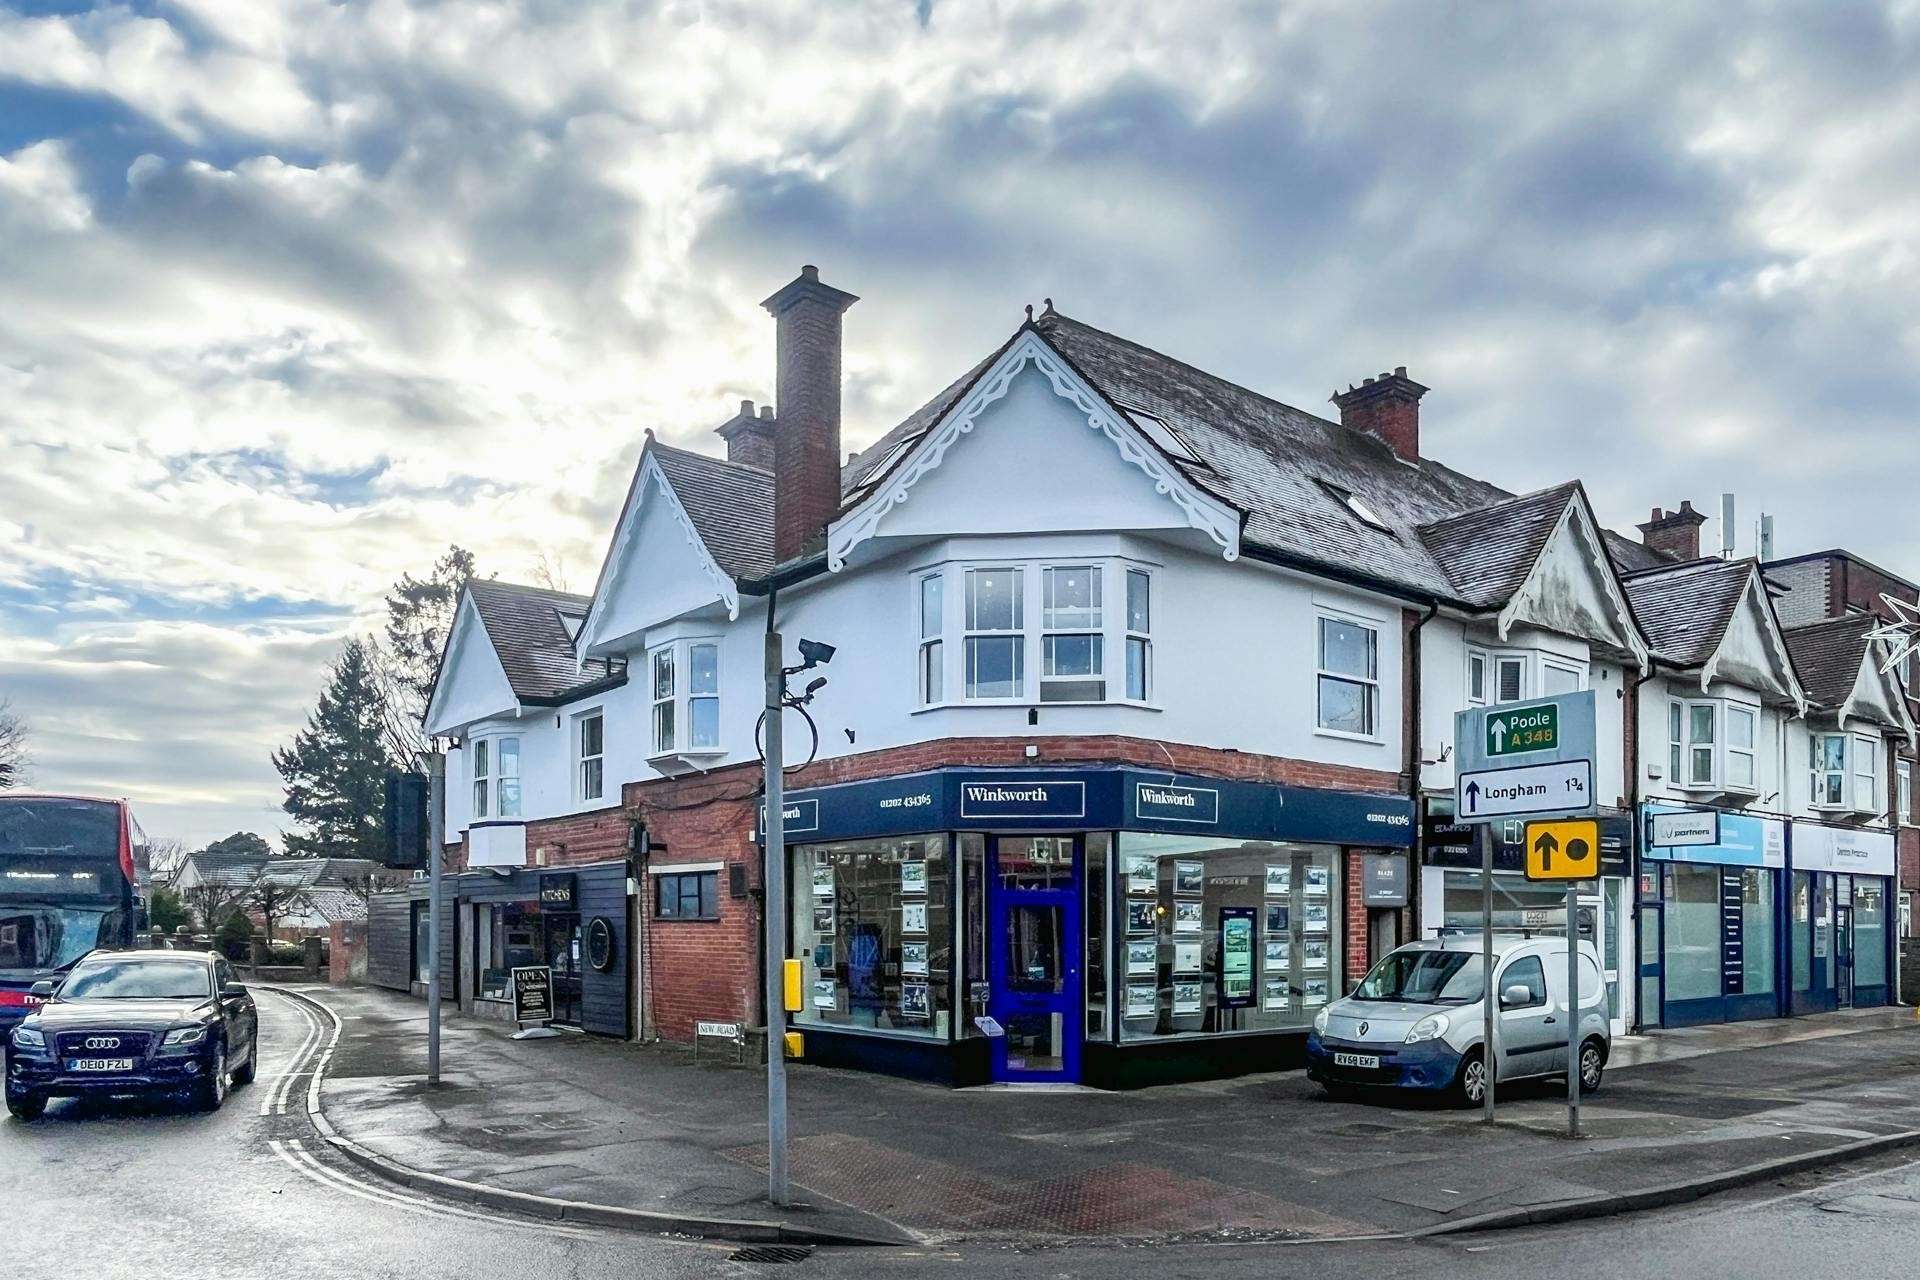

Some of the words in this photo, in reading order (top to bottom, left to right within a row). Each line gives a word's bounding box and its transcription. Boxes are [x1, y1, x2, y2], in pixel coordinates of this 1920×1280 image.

[1511, 712, 1550, 730] Poole
[1511, 733, 1521, 747] A
[1524, 728, 1553, 745] 348
[967, 787, 1048, 802] Winkworth
[1141, 788, 1195, 807] Winkworth
[1485, 783, 1547, 800] Longham
[880, 798, 902, 808] 01202
[903, 793, 932, 807] 434365
[1674, 829, 1710, 837] partners
[516, 970, 547, 981] OPEN
[107, 1060, 129, 1069] FZL
